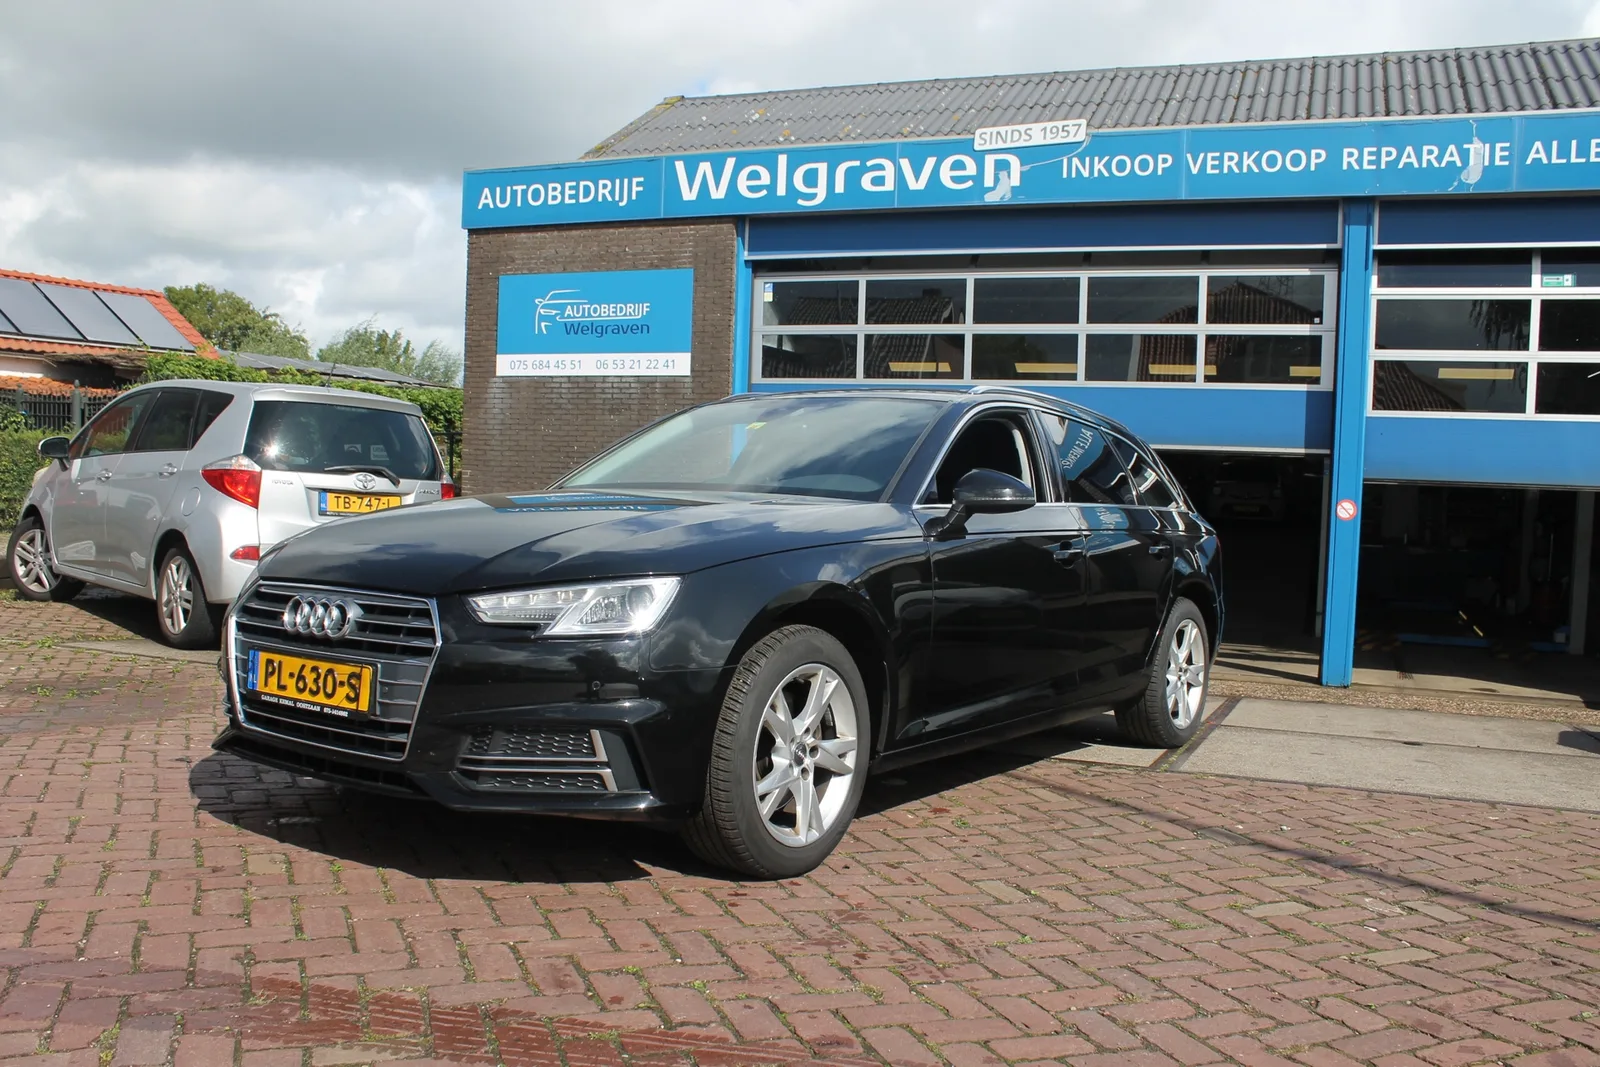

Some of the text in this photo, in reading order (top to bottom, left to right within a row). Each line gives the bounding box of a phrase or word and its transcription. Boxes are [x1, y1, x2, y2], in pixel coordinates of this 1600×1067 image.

[978, 123, 1082, 146] SINDS 1957
[1061, 153, 1174, 179] INKOOP
[1186, 148, 1327, 176] VERKOOP
[1341, 141, 1511, 171] REPARATIE
[477, 177, 645, 210] AUTOBEDRIJF
[674, 153, 1021, 207] Welgraven
[563, 303, 651, 319] AUTOBEDRIJF
[563, 321, 651, 339] Welgraven
[509, 358, 676, 371] 075 684 45 51 06 53 21 22 41
[264, 658, 362, 705] PL-630-S
